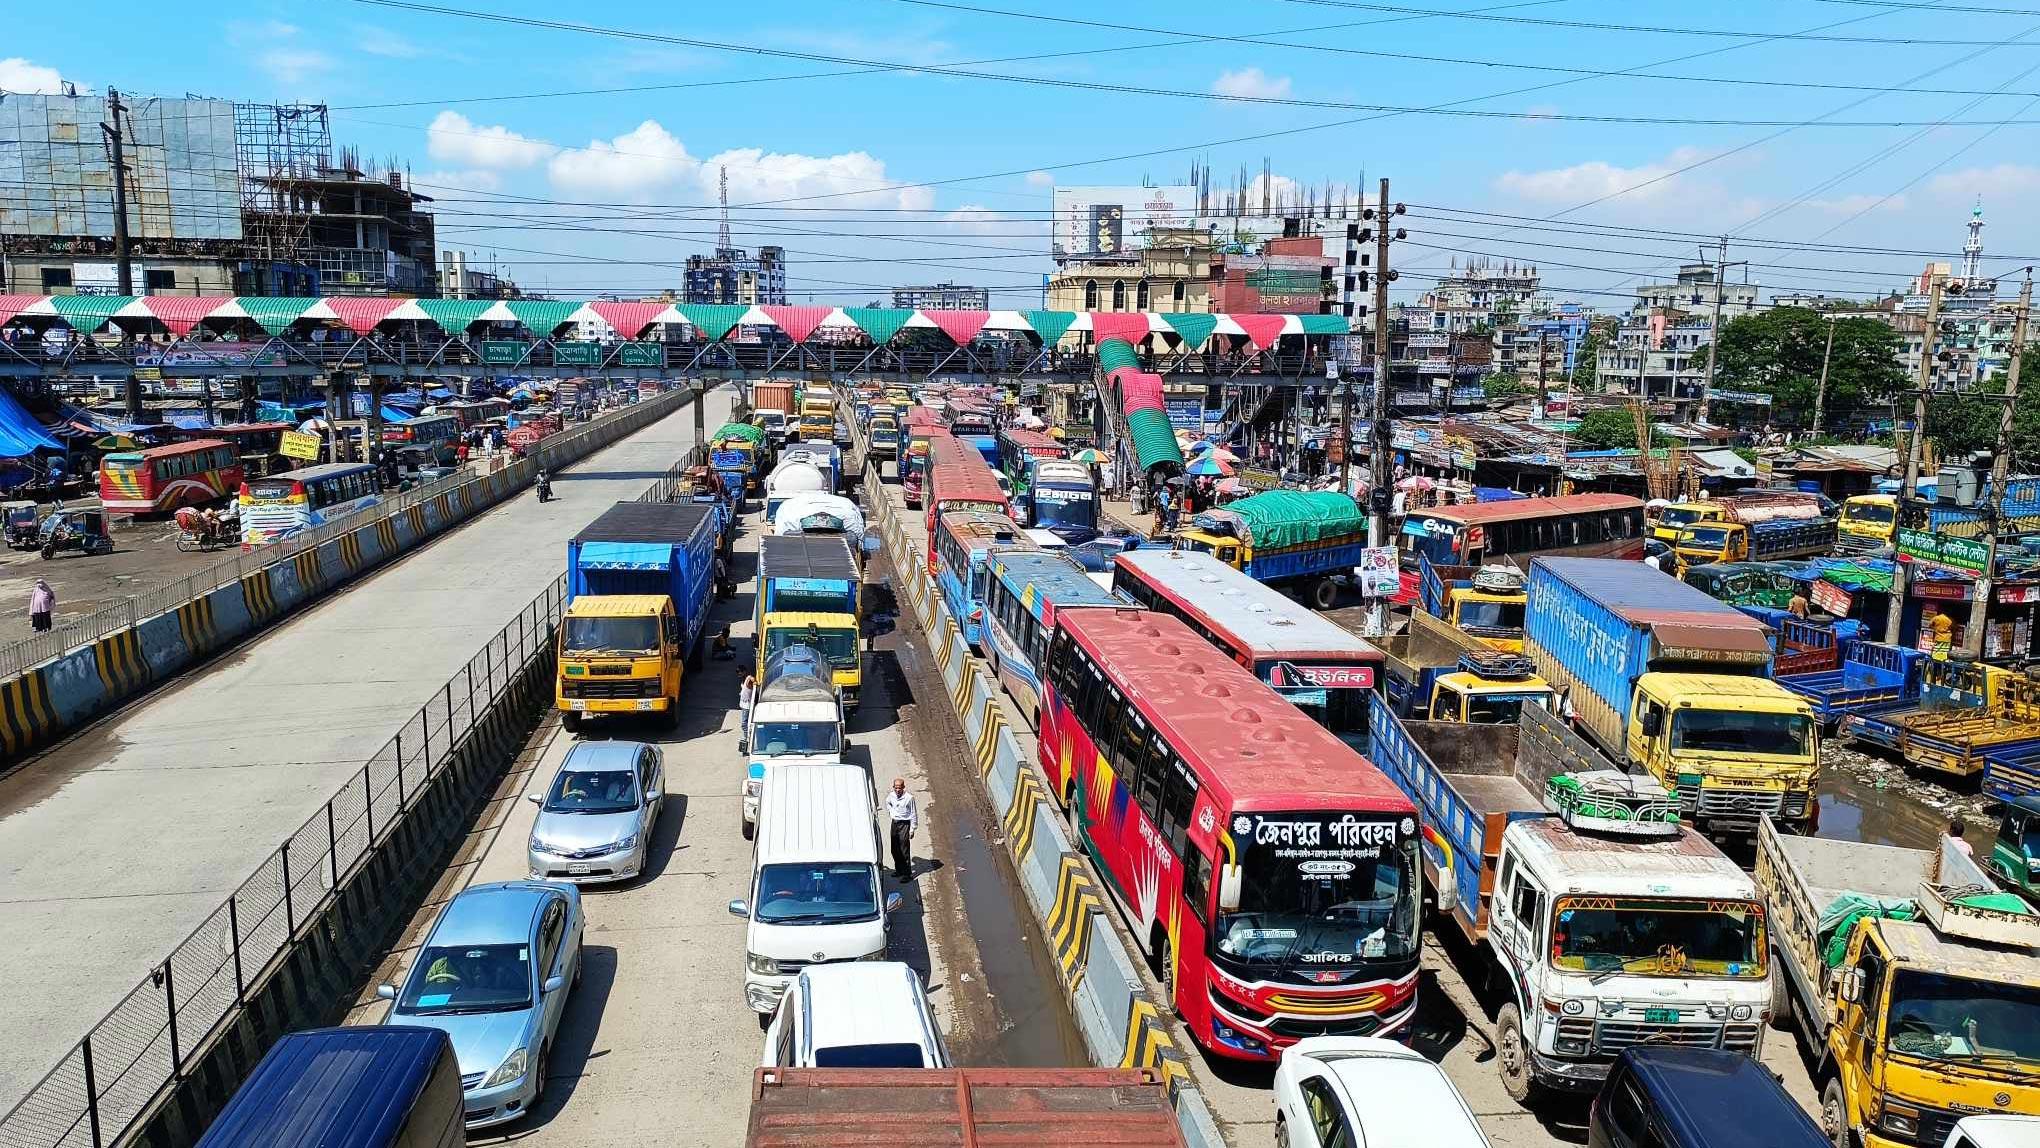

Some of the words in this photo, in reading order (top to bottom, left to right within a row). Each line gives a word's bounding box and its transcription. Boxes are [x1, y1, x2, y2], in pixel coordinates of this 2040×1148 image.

[1303, 669, 1367, 683] ইউনিক
[1255, 815, 1321, 847] জৈনপুর
[1328, 814, 1397, 846] পরিবহন
[1300, 951, 1353, 963] আলিফ
